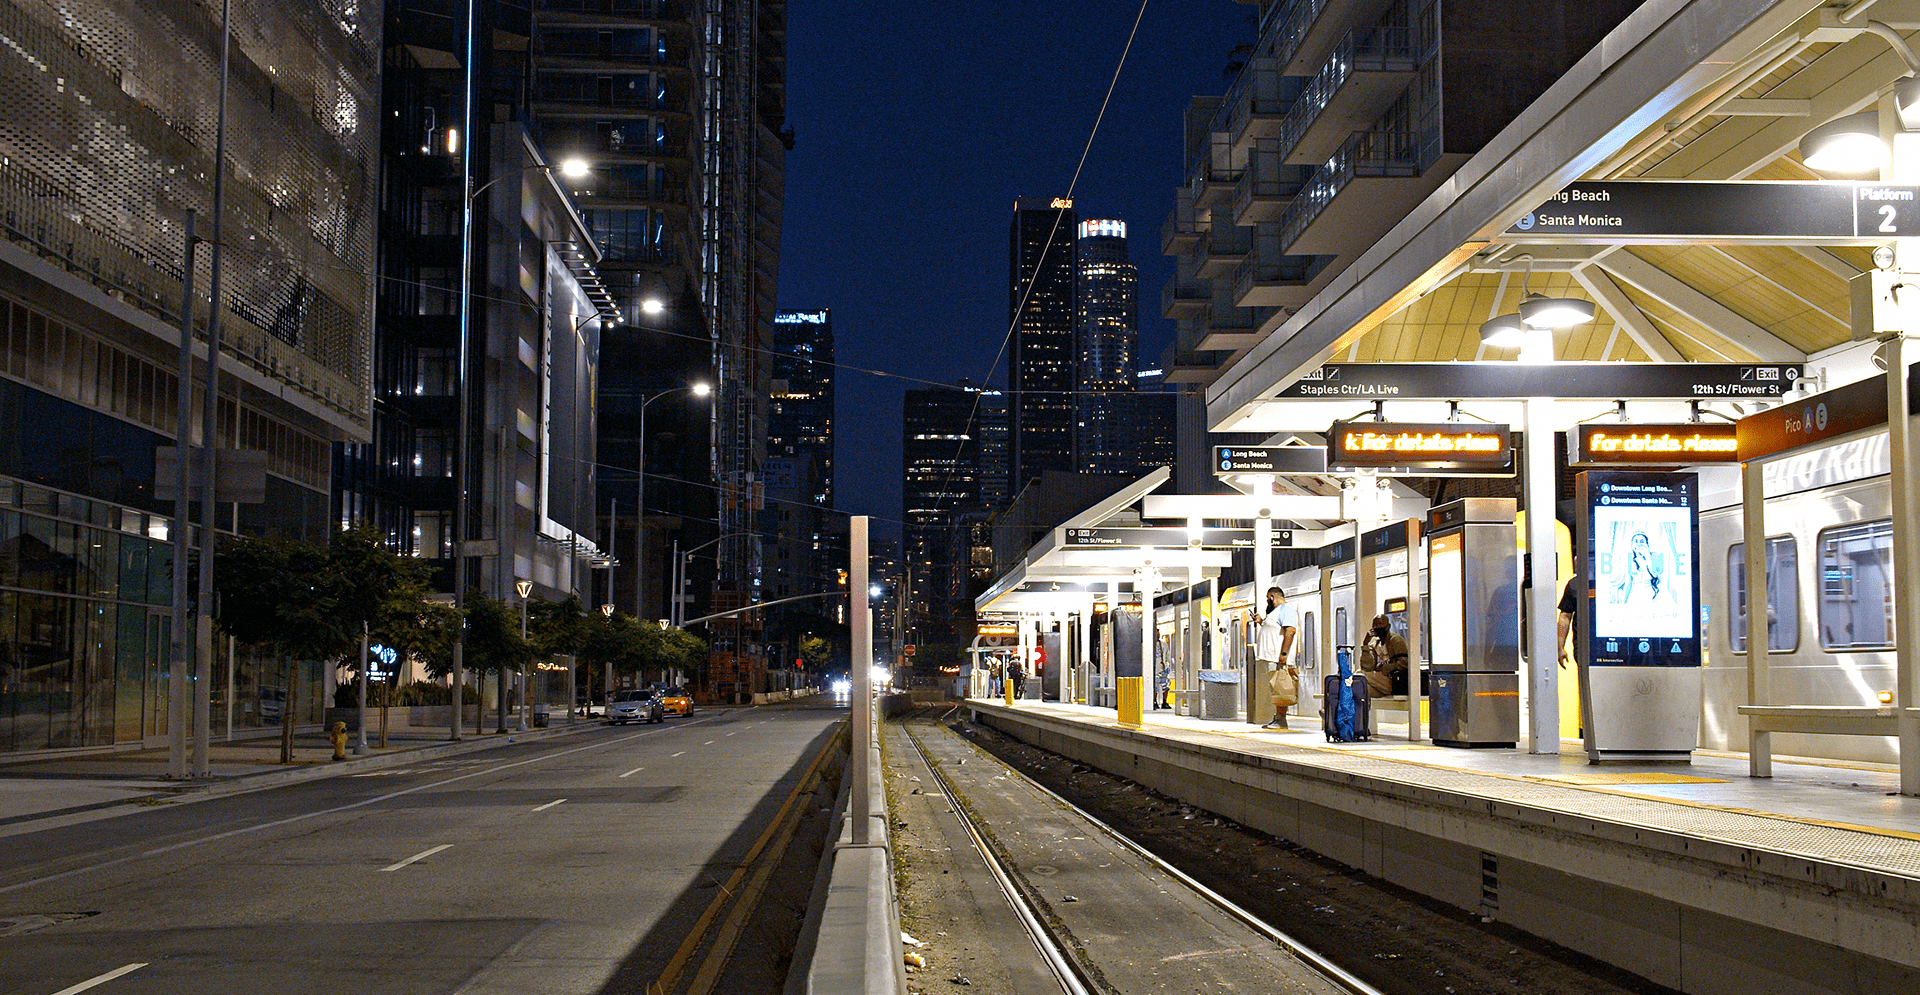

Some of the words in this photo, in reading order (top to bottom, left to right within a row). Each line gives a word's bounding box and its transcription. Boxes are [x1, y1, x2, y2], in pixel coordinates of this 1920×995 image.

[1572, 190, 1610, 201] Beach
[1860, 187, 1915, 201] Platform
[1539, 214, 1575, 226] Santa
[1578, 214, 1623, 226] Monica
[1878, 204, 1897, 233] 2
[1303, 368, 1322, 379] xit
[1758, 368, 1778, 379] Exit
[1300, 384, 1339, 396] Staples
[1341, 384, 1376, 395] Ctr/LA
[1377, 384, 1399, 395] Live
[1692, 384, 1714, 394] 12th
[1715, 384, 1767, 395] St/Flower
[1768, 384, 1780, 394] St
[1785, 417, 1802, 434] Pico
[1805, 413, 1812, 429] A
[1591, 433, 1622, 451] For
[1232, 450, 1248, 458] Long
[1249, 450, 1268, 458] Beach
[1251, 461, 1273, 469] Monica
[1641, 485, 1656, 493] Long
